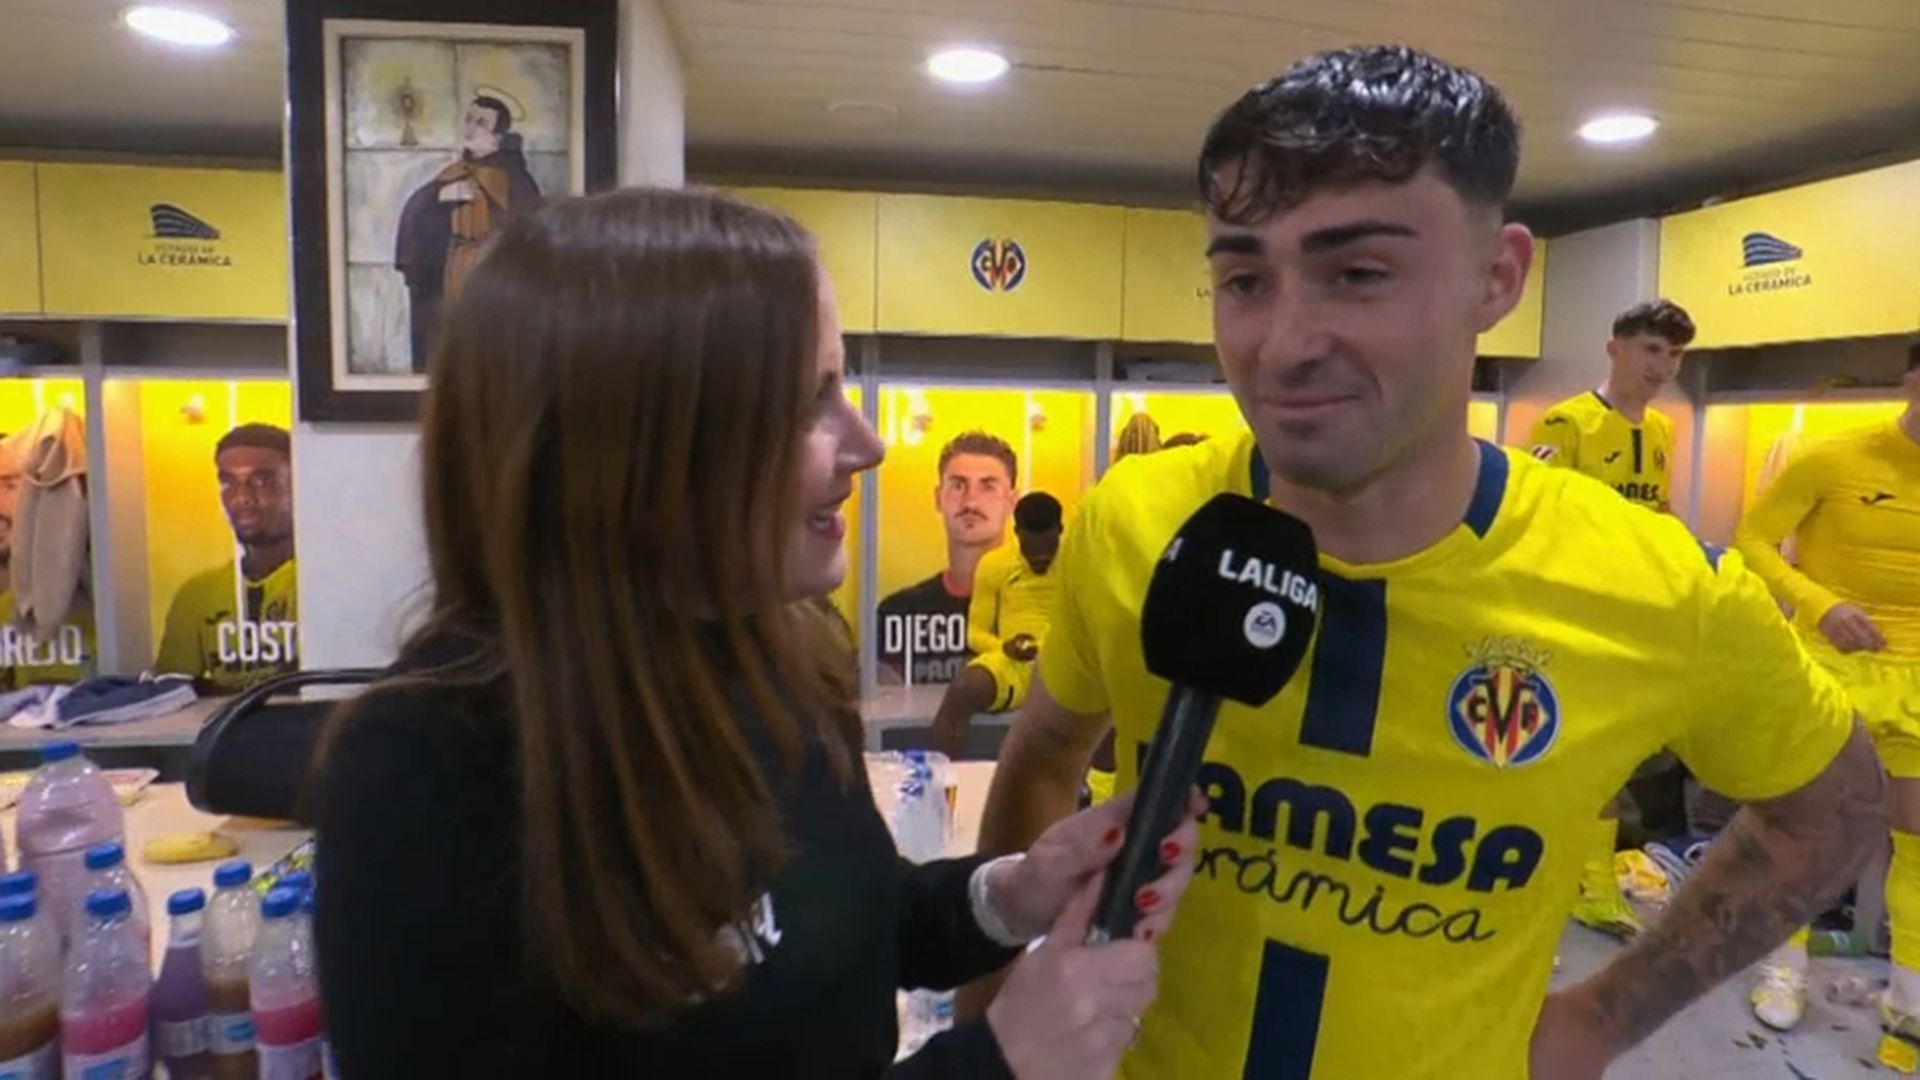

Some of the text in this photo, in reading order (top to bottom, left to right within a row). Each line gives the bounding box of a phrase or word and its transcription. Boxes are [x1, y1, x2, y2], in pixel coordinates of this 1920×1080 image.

[1218, 549, 1318, 615] LALIGA
[0, 625, 82, 667] REJO
[218, 620, 297, 663] COST
[885, 613, 966, 654] DIEGO
[1138, 741, 1544, 893] AMESA
[1194, 847, 1496, 942] rámica
